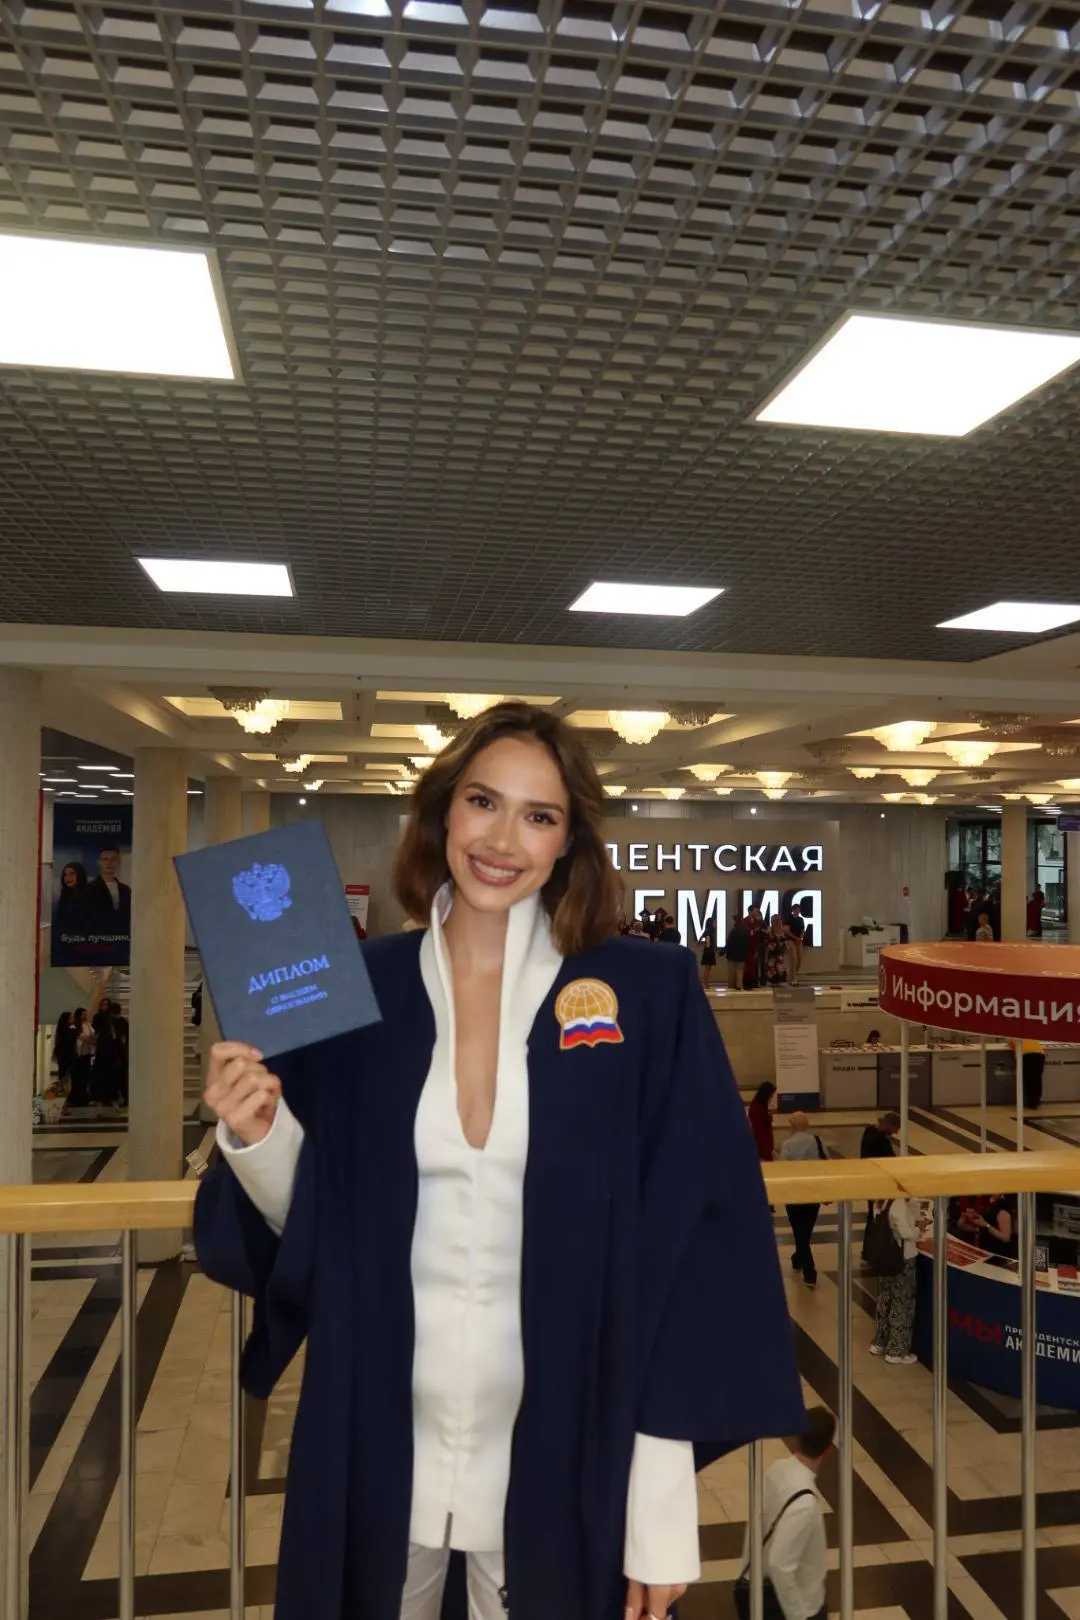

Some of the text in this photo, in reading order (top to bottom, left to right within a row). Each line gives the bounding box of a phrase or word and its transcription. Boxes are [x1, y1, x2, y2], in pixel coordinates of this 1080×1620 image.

[61, 933, 86, 944] Будь
[248, 954, 331, 996] ДИПЛОМ
[1004, 1325, 1080, 1347] ПРЕДЕНТСК
[1005, 1335, 1080, 1364] АКДЕМИ
